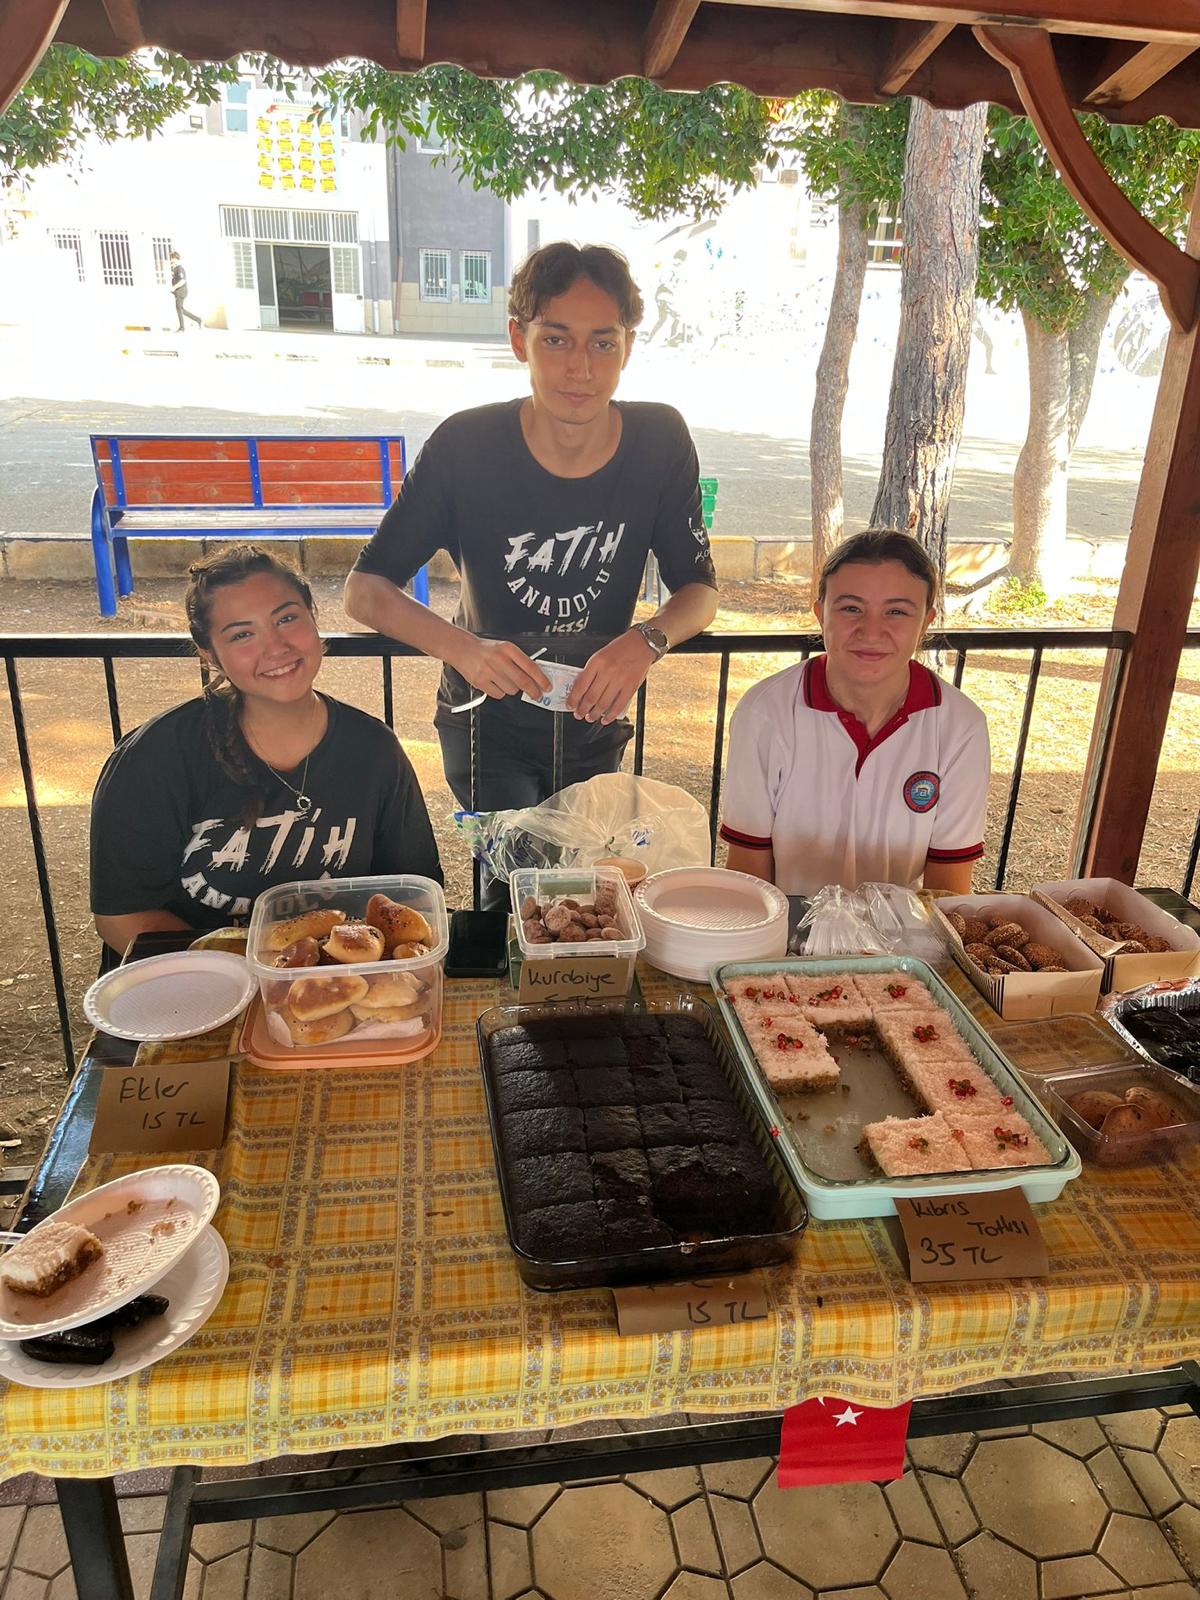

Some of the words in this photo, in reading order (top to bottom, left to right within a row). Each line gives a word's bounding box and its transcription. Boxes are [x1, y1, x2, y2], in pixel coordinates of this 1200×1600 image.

[507, 568, 610, 618] ANADOLU
[119, 1076, 190, 1104] Ekler
[142, 1111, 167, 1130] 15
[175, 1111, 207, 1128] TL
[920, 1236, 957, 1266] 35
[962, 1246, 1003, 1265] TL
[687, 1300, 712, 1324] 15
[724, 1301, 769, 1324] TL
